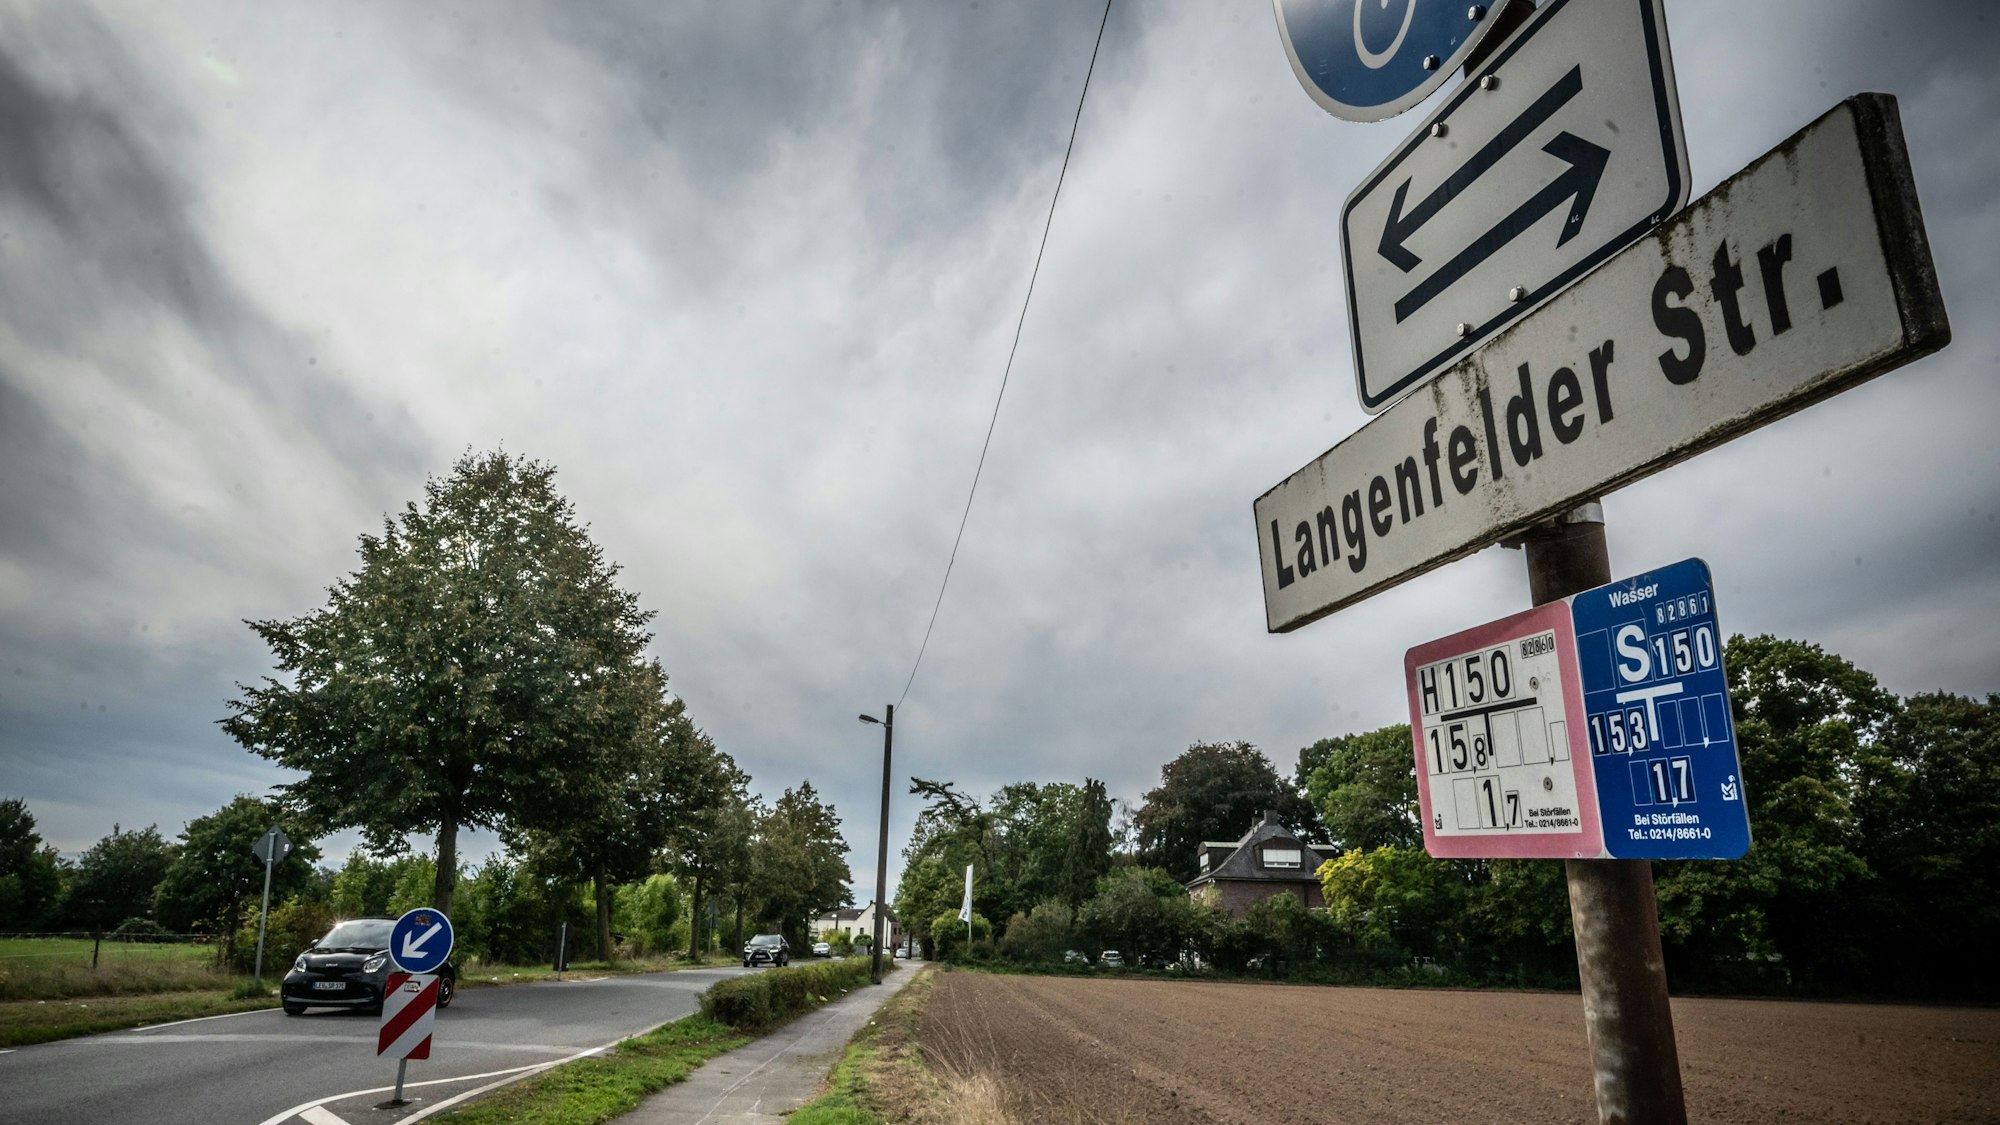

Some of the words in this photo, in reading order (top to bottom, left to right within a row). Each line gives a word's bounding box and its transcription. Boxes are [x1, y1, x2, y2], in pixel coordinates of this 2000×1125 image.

[1270, 338, 1615, 590] Langenfelder
[1652, 233, 1844, 386] Str.
[1608, 583, 1659, 608] Wasser
[1656, 596, 1709, 624] 82861
[1522, 636, 1554, 657] 82860
[1528, 809, 1539, 817] Bei
[1540, 808, 1571, 817] Störfällen
[1634, 814, 1650, 826] Bei
[1651, 813, 1700, 825] Störfällen
[1524, 819, 1538, 829] Tel.:
[1538, 818, 1579, 829] 0214/8661-0
[1628, 828, 1648, 840] Tel.:
[1649, 827, 1711, 841] 0214/8661-0
